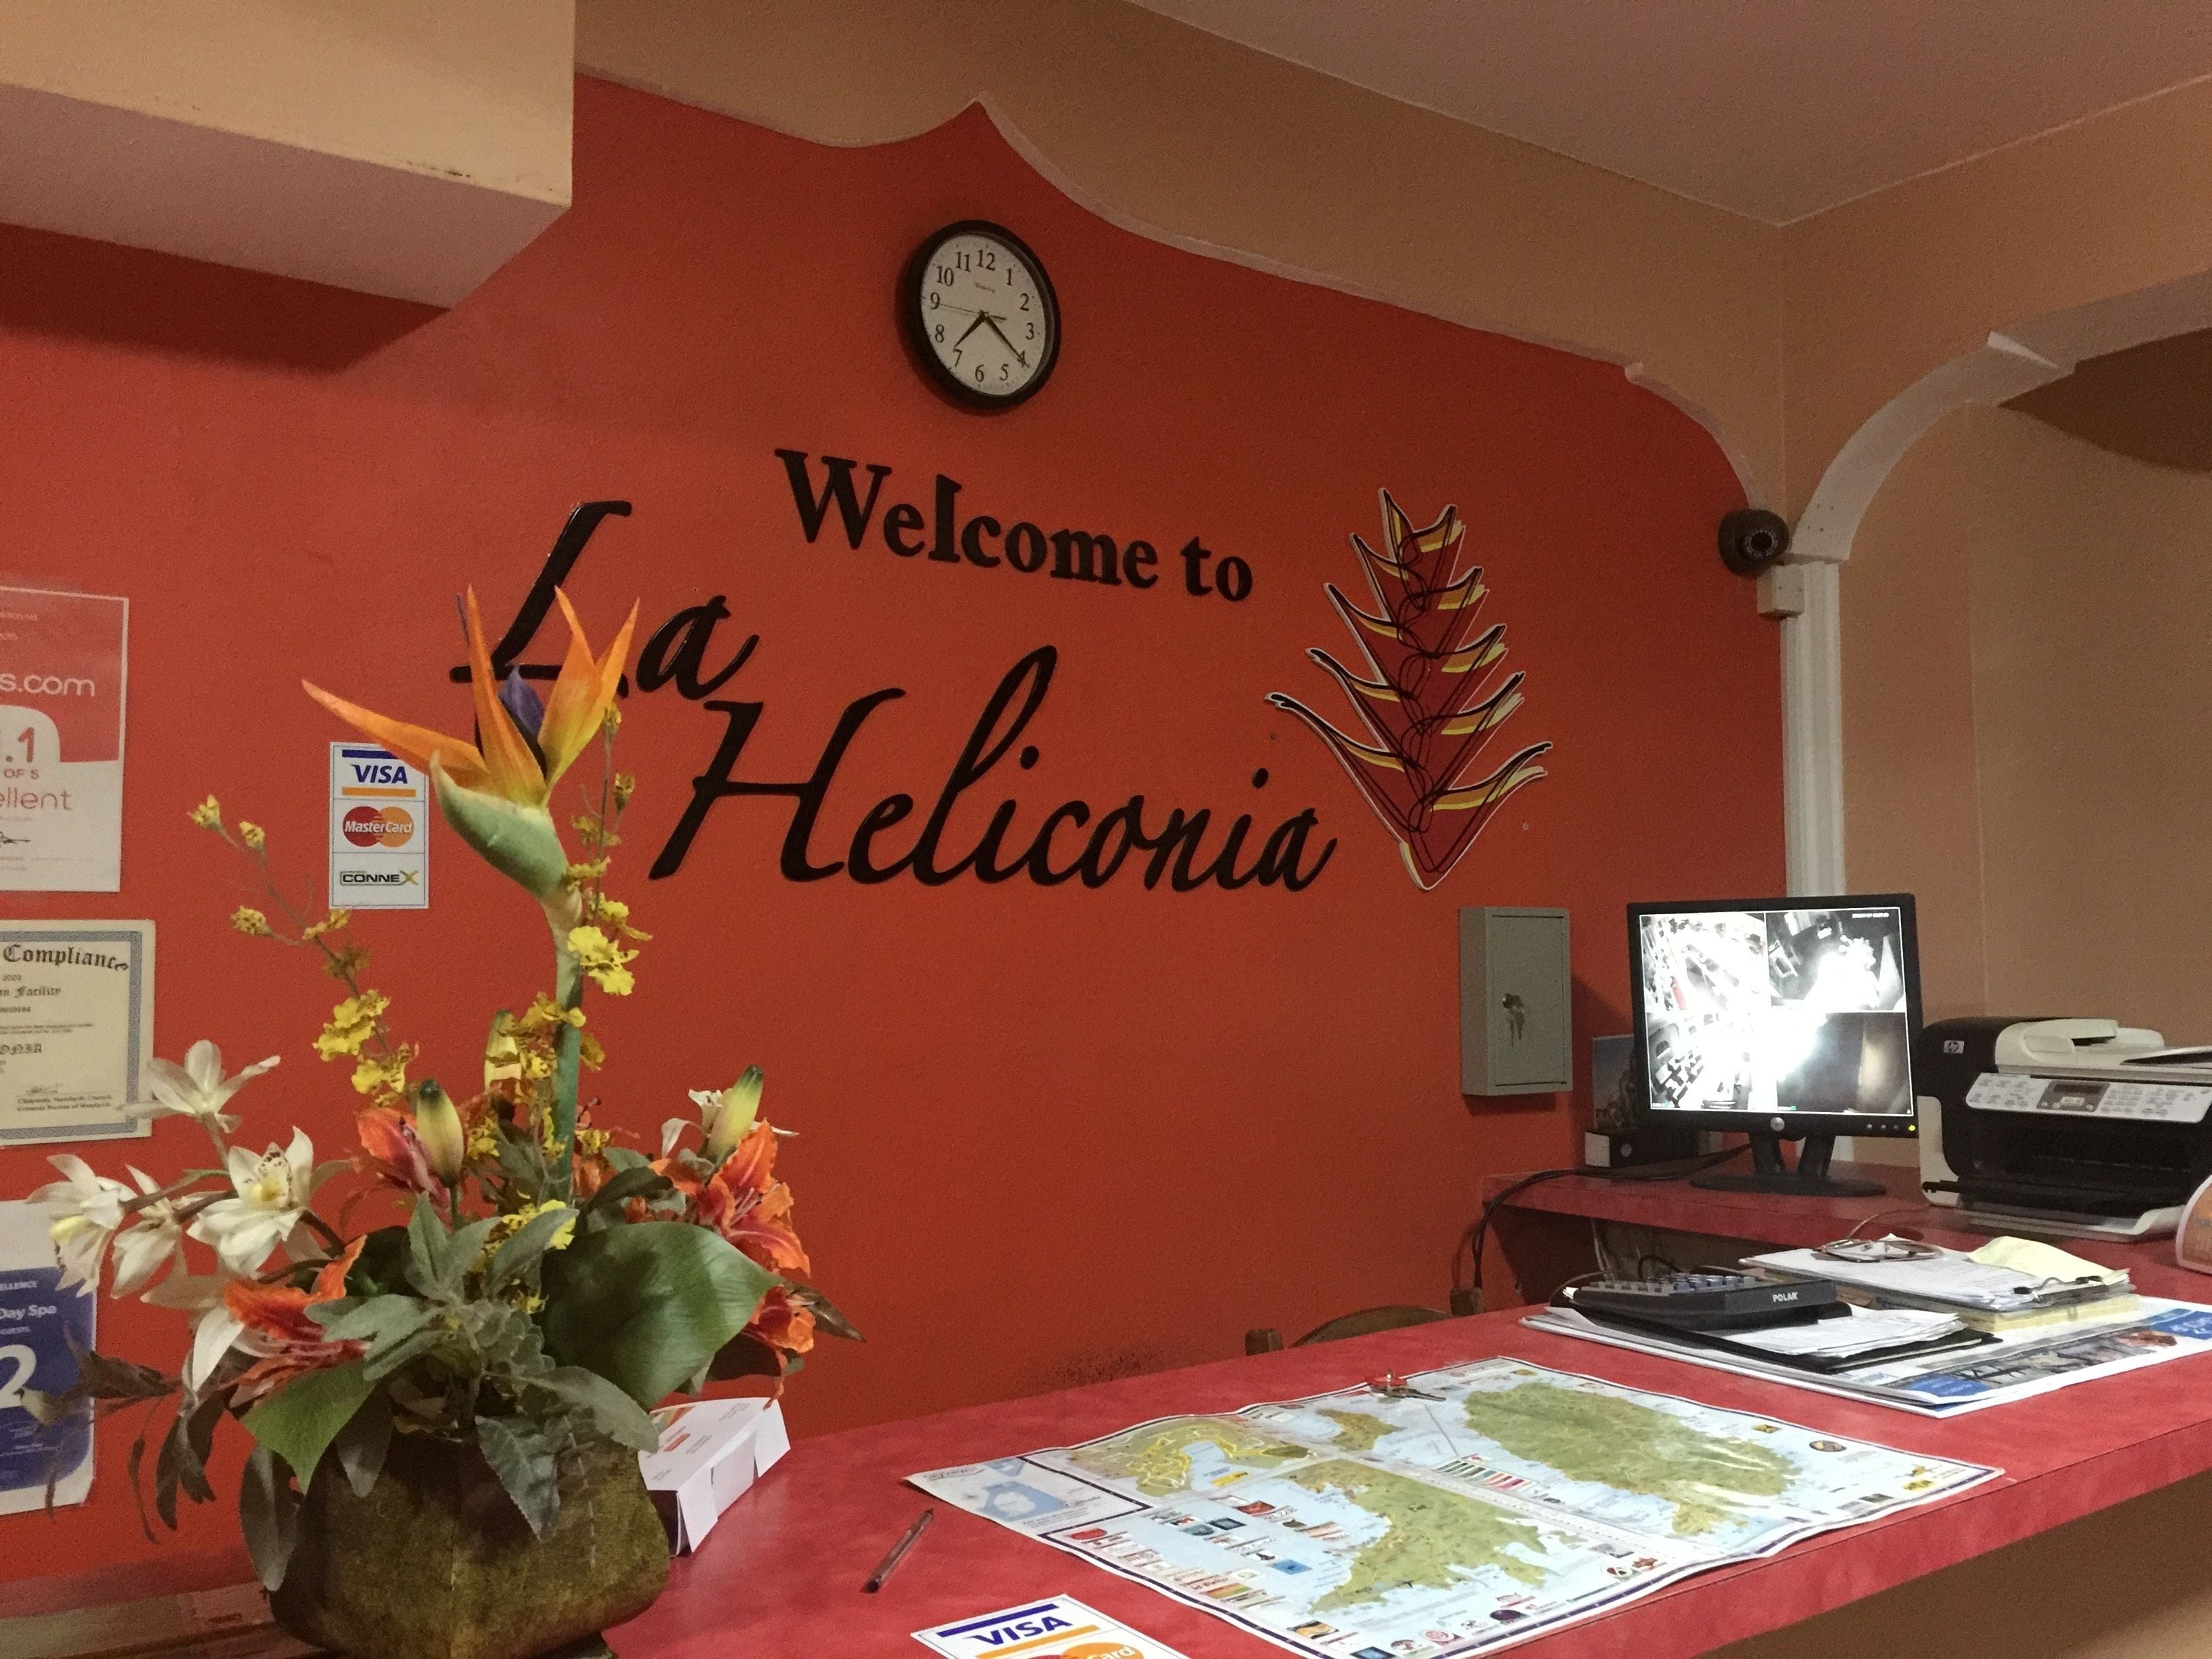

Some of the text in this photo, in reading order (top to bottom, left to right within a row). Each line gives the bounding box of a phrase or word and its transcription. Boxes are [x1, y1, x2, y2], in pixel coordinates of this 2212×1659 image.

[955, 251, 971, 272] 11
[976, 249, 997, 271] 12
[936, 265, 954, 287] 10
[1006, 268, 1013, 286] 1
[929, 291, 941, 310] 9
[1019, 293, 1030, 312] 2
[935, 324, 945, 343] 8
[1025, 322, 1035, 340] 3
[953, 348, 963, 367] 7
[975, 365, 985, 382] 6
[999, 363, 1010, 381] 5
[775, 448, 1253, 602] Welcome to
[449, 500, 760, 701] La
[3, 769, 25, 779] OF
[352, 764, 408, 784] VISA
[648, 644, 1337, 892] Heliconia
[344, 819, 413, 834] MasterCard
[342, 870, 419, 886] CONNEX
[3, 944, 129, 971] Compliance
[1772, 1292, 1799, 1303] POLAR
[27, 1304, 57, 1318] Spa
[963, 1616, 1073, 1645] VISA
